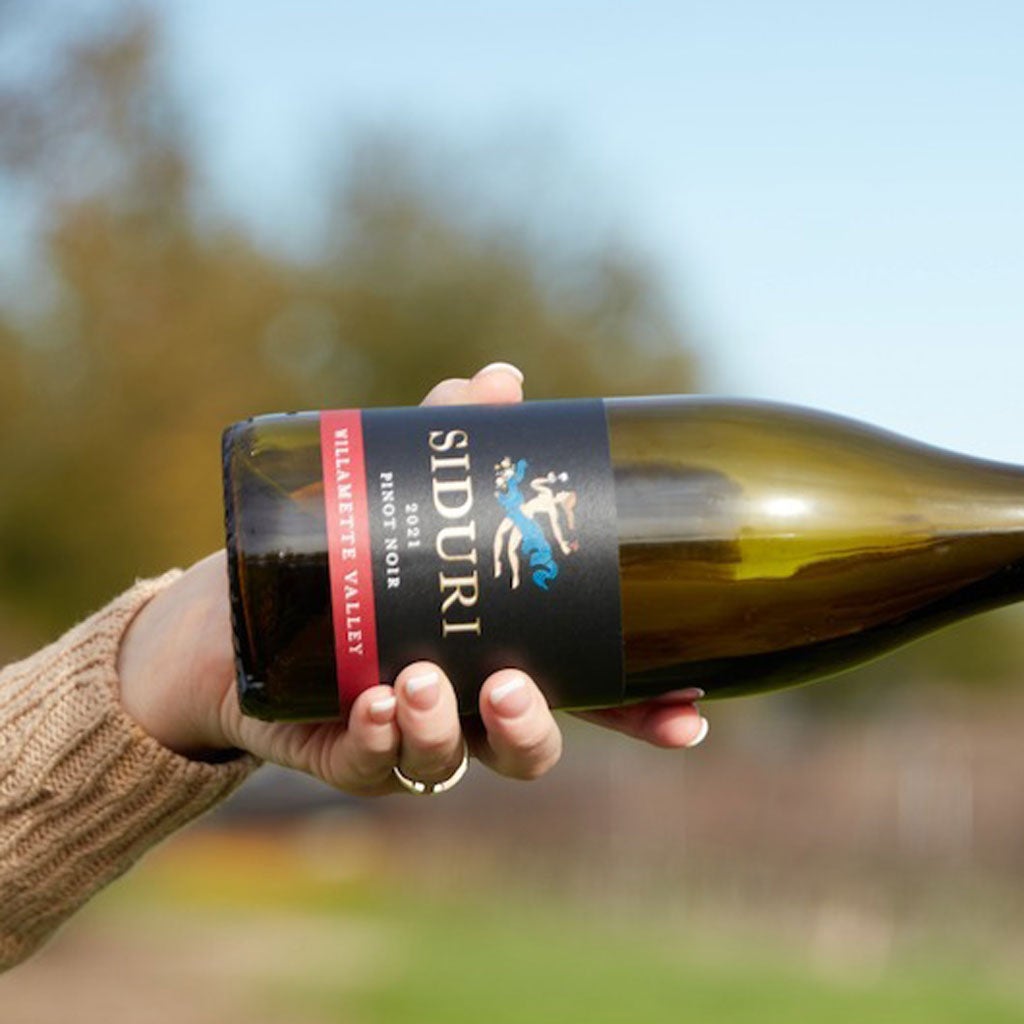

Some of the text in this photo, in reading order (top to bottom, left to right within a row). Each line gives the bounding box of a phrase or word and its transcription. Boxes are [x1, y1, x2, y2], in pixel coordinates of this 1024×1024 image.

[333, 428, 363, 656] WILLAMETTE VALLEY
[380, 471, 400, 590] PINOT NOIR
[405, 502, 420, 549] 2021
[428, 429, 481, 637] SIDURI
